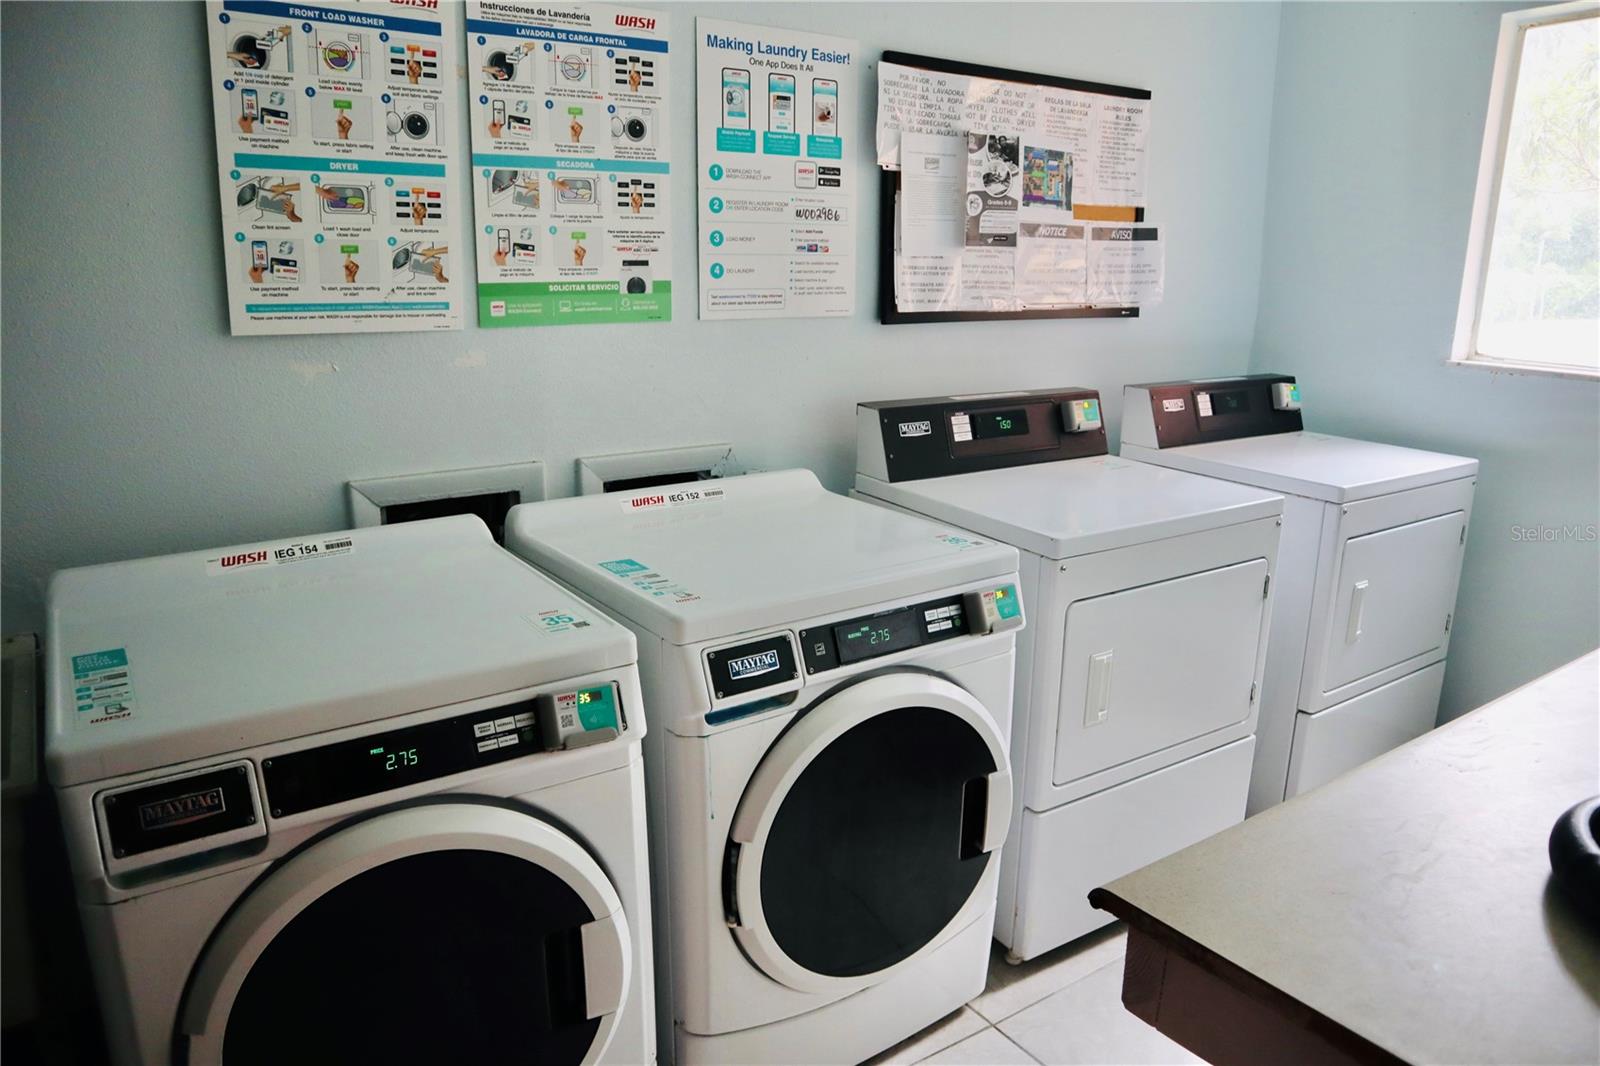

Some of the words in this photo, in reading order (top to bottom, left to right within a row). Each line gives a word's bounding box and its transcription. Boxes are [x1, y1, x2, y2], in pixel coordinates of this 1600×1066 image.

[480, 2, 535, 15] Instrucciones
[537, 8, 546, 16] de
[289, 8, 318, 18] FRONT
[322, 12, 346, 22] LOAD
[349, 15, 385, 26] WASHER
[616, 14, 656, 29] WASH
[516, 28, 555, 39] LAVADORA
[569, 34, 593, 43] CARGA
[595, 38, 626, 47] FRONTAL
[707, 34, 753, 55] Making
[757, 41, 807, 62] Laundry
[811, 48, 850, 65] Easier!
[749, 57, 763, 66] One
[765, 60, 779, 70] App
[781, 61, 798, 70] Does
[805, 64, 814, 72] All
[933, 87, 964, 96] LAVADORA
[1002, 99, 1024, 107] WASHER
[991, 107, 1017, 116] CLOTHES
[917, 120, 951, 129] SOBRECARGA
[329, 162, 358, 171] DRYER
[556, 160, 595, 169] SECADORA
[1039, 226, 1068, 236] NOTICE
[1111, 230, 1132, 240] AVISO
[901, 422, 929, 432] MAYTAG
[632, 496, 664, 507] WASH
[669, 494, 684, 502] IEG
[221, 551, 267, 567] WASH
[274, 548, 295, 559] IEG
[299, 545, 318, 555] 154
[541, 614, 574, 625] 35
[870, 628, 890, 644] 2.75
[731, 653, 775, 672] MAYTAG
[739, 664, 769, 675] COMMERCIAL
[558, 694, 576, 702] WASH
[579, 693, 591, 704] 35
[370, 746, 384, 755] PRICE
[386, 749, 418, 770] 2.75
[144, 792, 218, 822] MAYTAG
